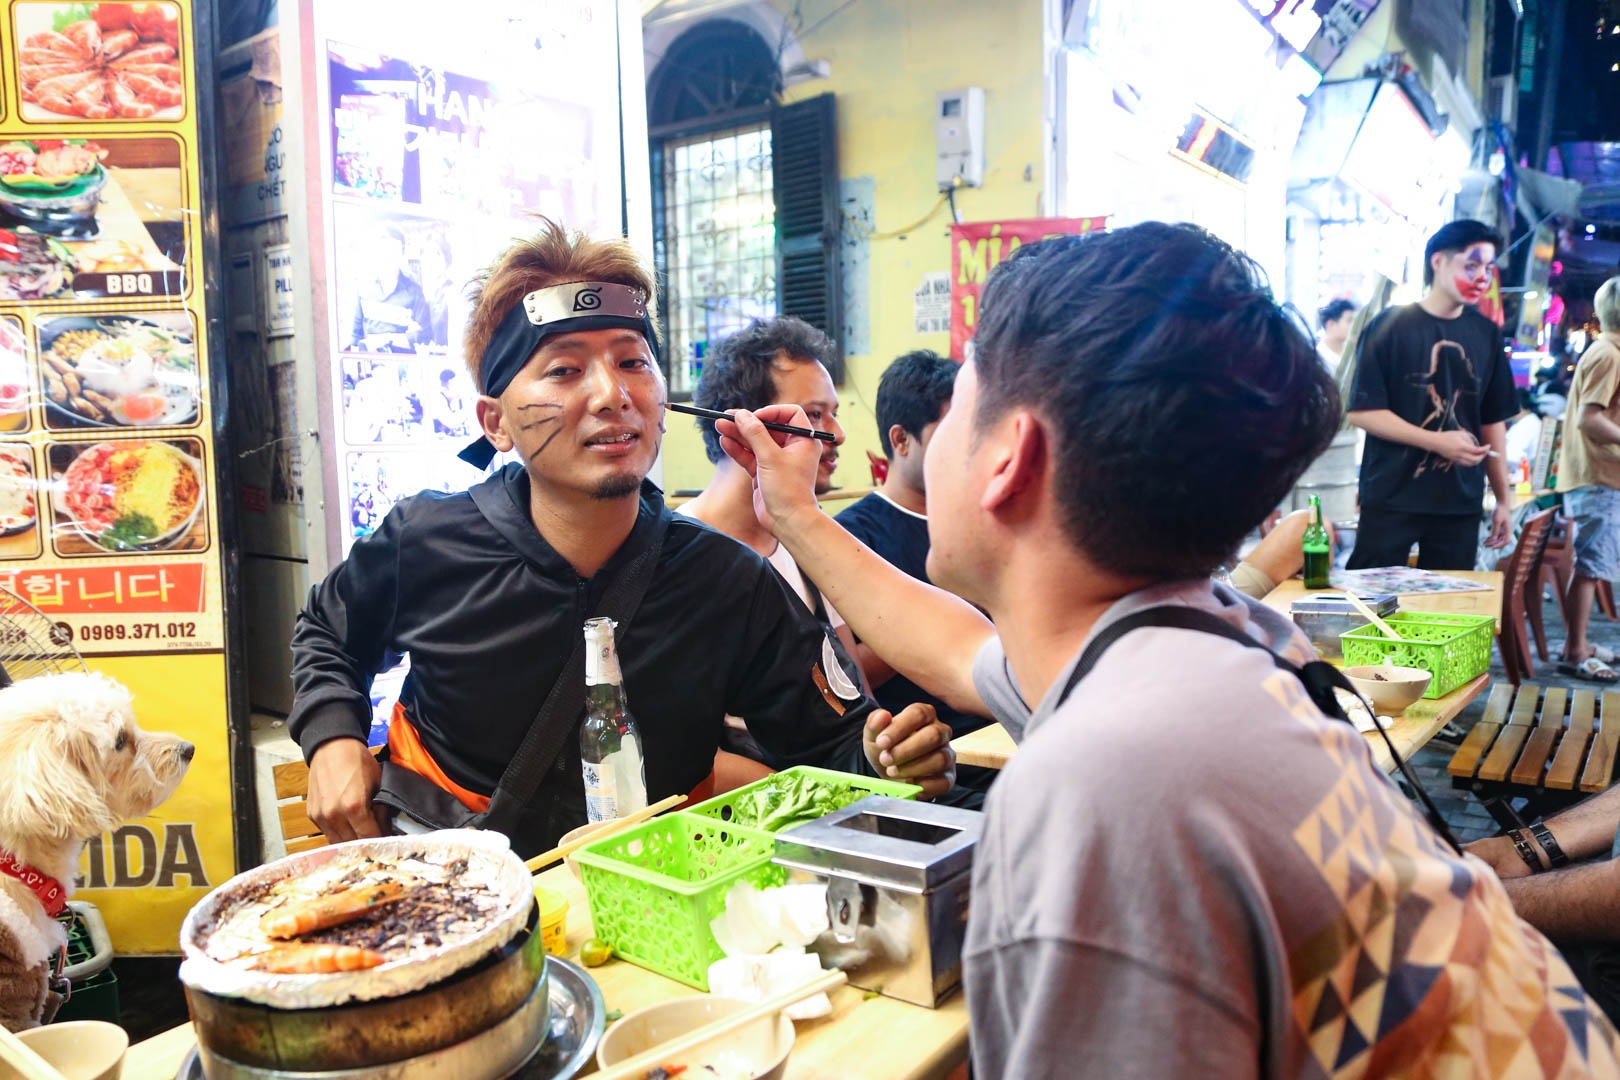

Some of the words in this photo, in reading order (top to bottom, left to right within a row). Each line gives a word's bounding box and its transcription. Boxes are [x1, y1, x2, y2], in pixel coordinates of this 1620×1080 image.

[106, 273, 152, 294] BBQ
[80, 622, 196, 641] 0989.371.012
[74, 824, 210, 888] IDA
